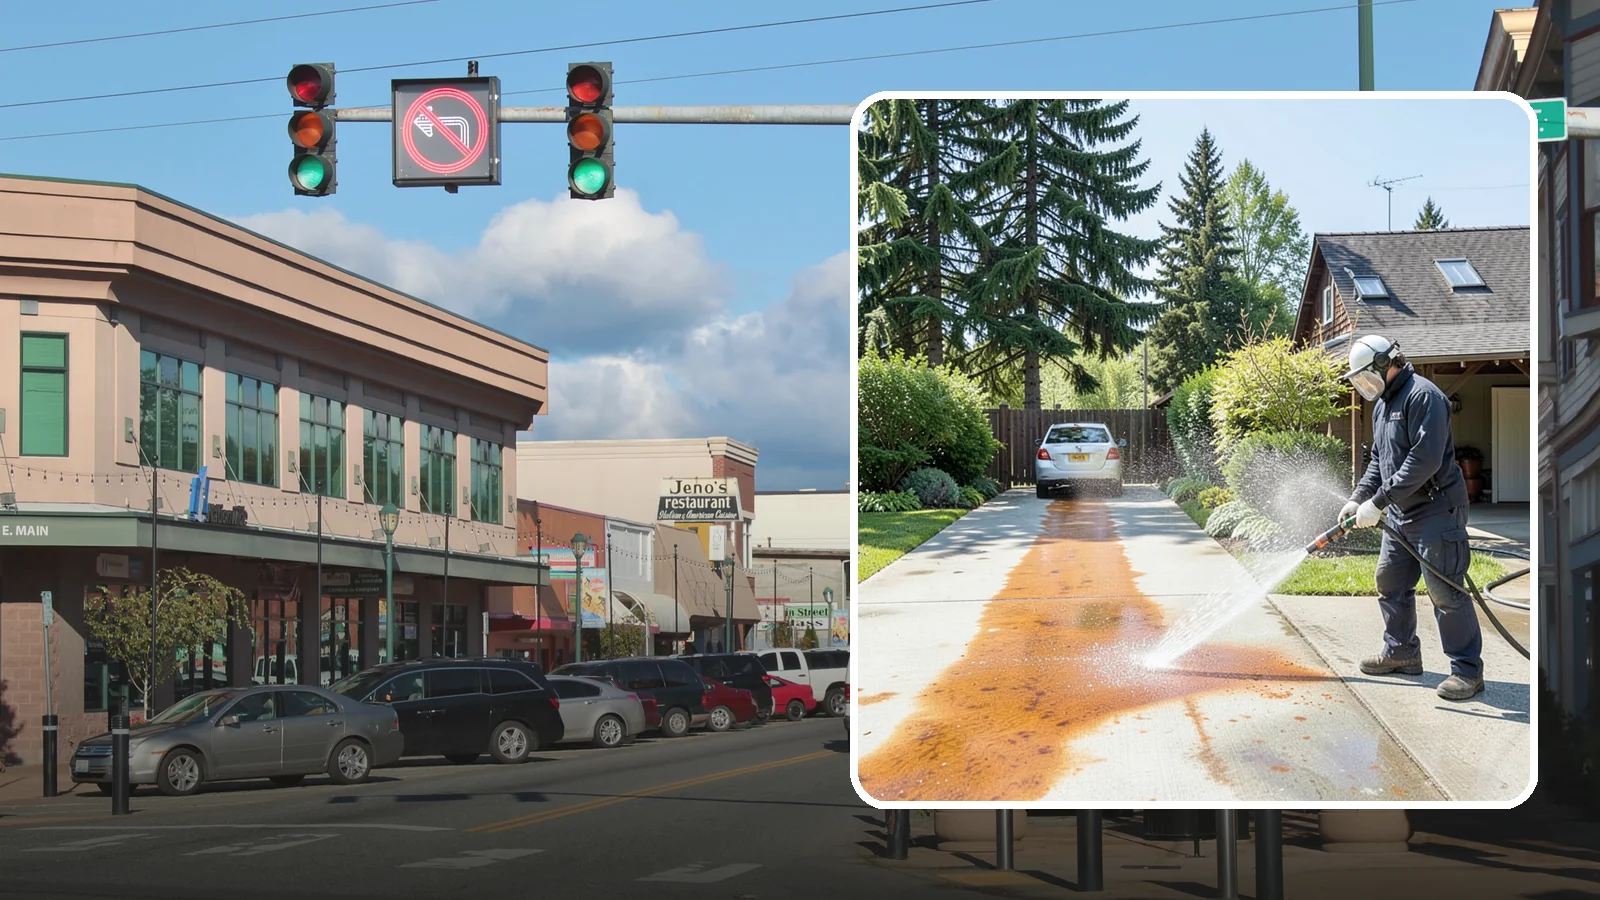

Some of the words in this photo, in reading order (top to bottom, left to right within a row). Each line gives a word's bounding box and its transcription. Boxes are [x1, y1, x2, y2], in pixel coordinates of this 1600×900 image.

[670, 480, 727, 494] Jeno's
[665, 496, 731, 509] restaurant
[658, 510, 682, 519] Italian
[686, 510, 714, 519] American
[715, 510, 738, 519] Cuisine
[2, 525, 13, 536] E.
[15, 525, 49, 536] MAIN
[797, 607, 829, 617] Street
